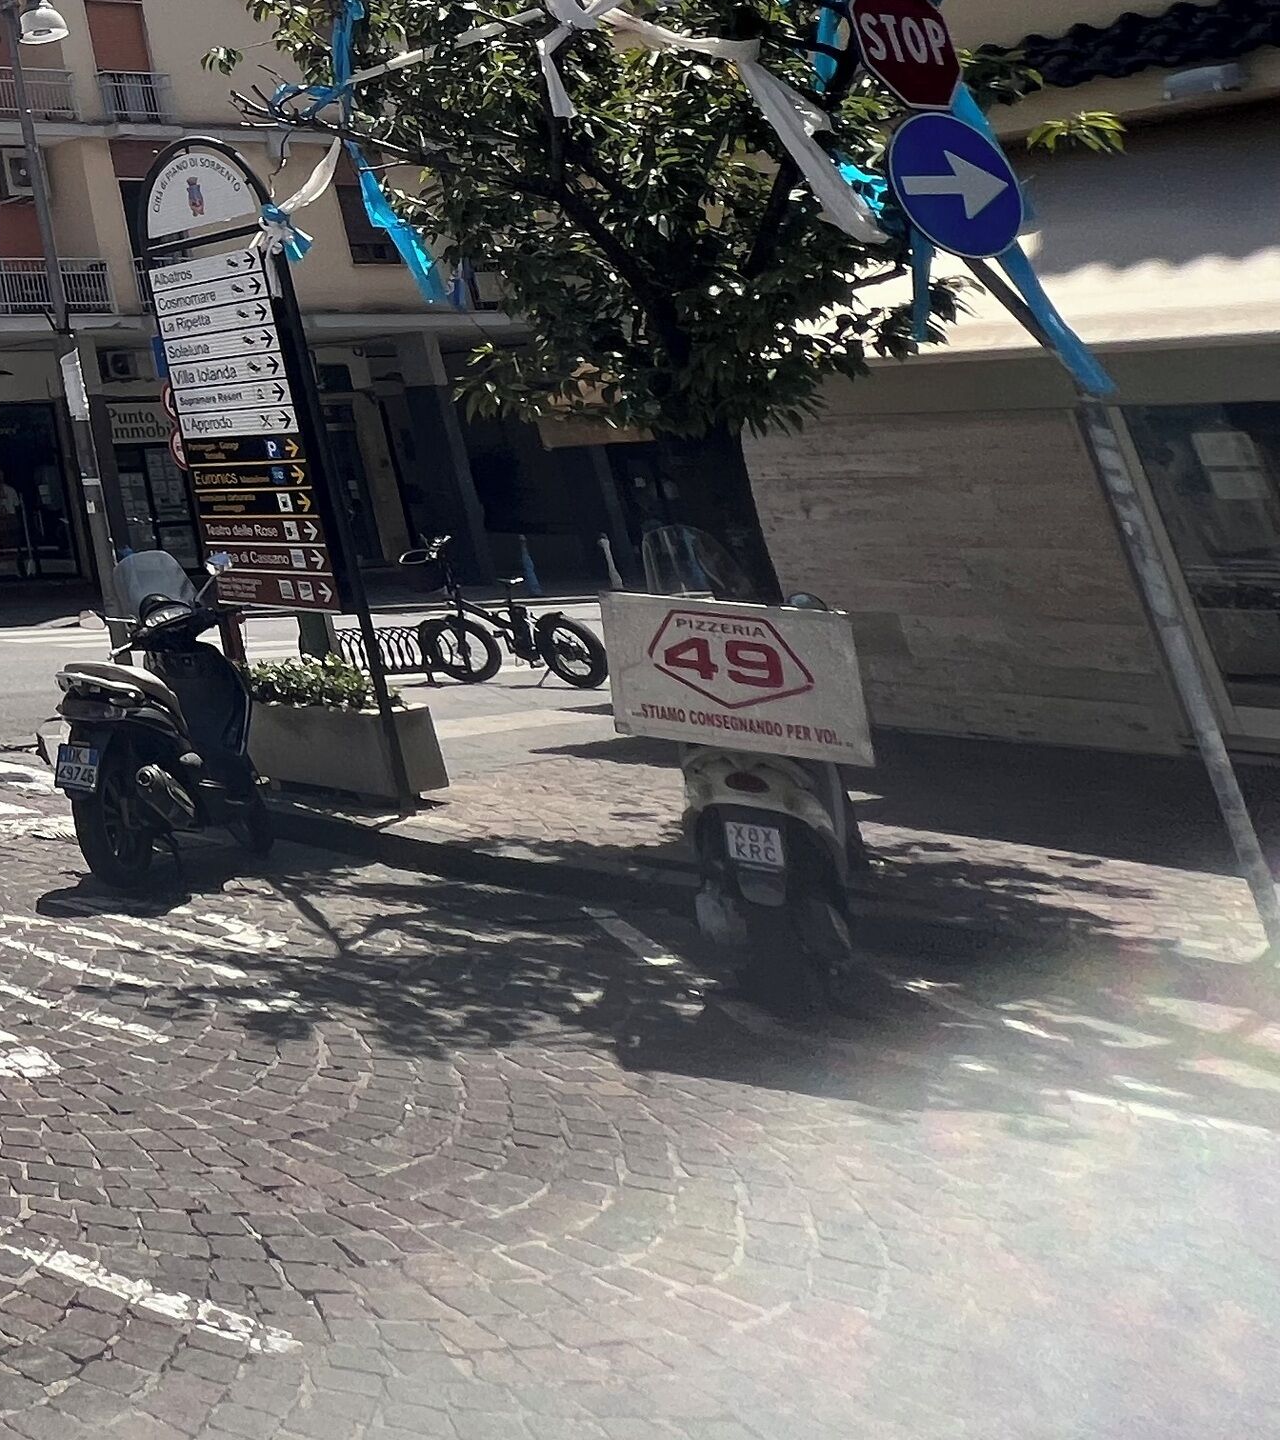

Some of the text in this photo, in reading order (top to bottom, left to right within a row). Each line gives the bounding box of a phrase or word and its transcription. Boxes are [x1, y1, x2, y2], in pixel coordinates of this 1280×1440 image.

[860, 13, 946, 66] STOP
[165, 162, 189, 181] PIANO
[189, 158, 198, 168] DI
[200, 157, 241, 192] SORRENTO
[154, 269, 193, 286] Albatros
[162, 322, 175, 333] La
[172, 370, 196, 385] Villa
[112, 421, 172, 439] mmobi
[182, 416, 233, 433] L'Approdo
[193, 471, 238, 485] Euronics
[205, 523, 231, 536] Teatro
[254, 524, 278, 537] Rose
[676, 618, 766, 638] PIZZERIA
[664, 636, 784, 688] 49
[689, 710, 783, 736] CONSEGNANDO
[786, 724, 813, 741] PER
[735, 842, 778, 863] KRC
